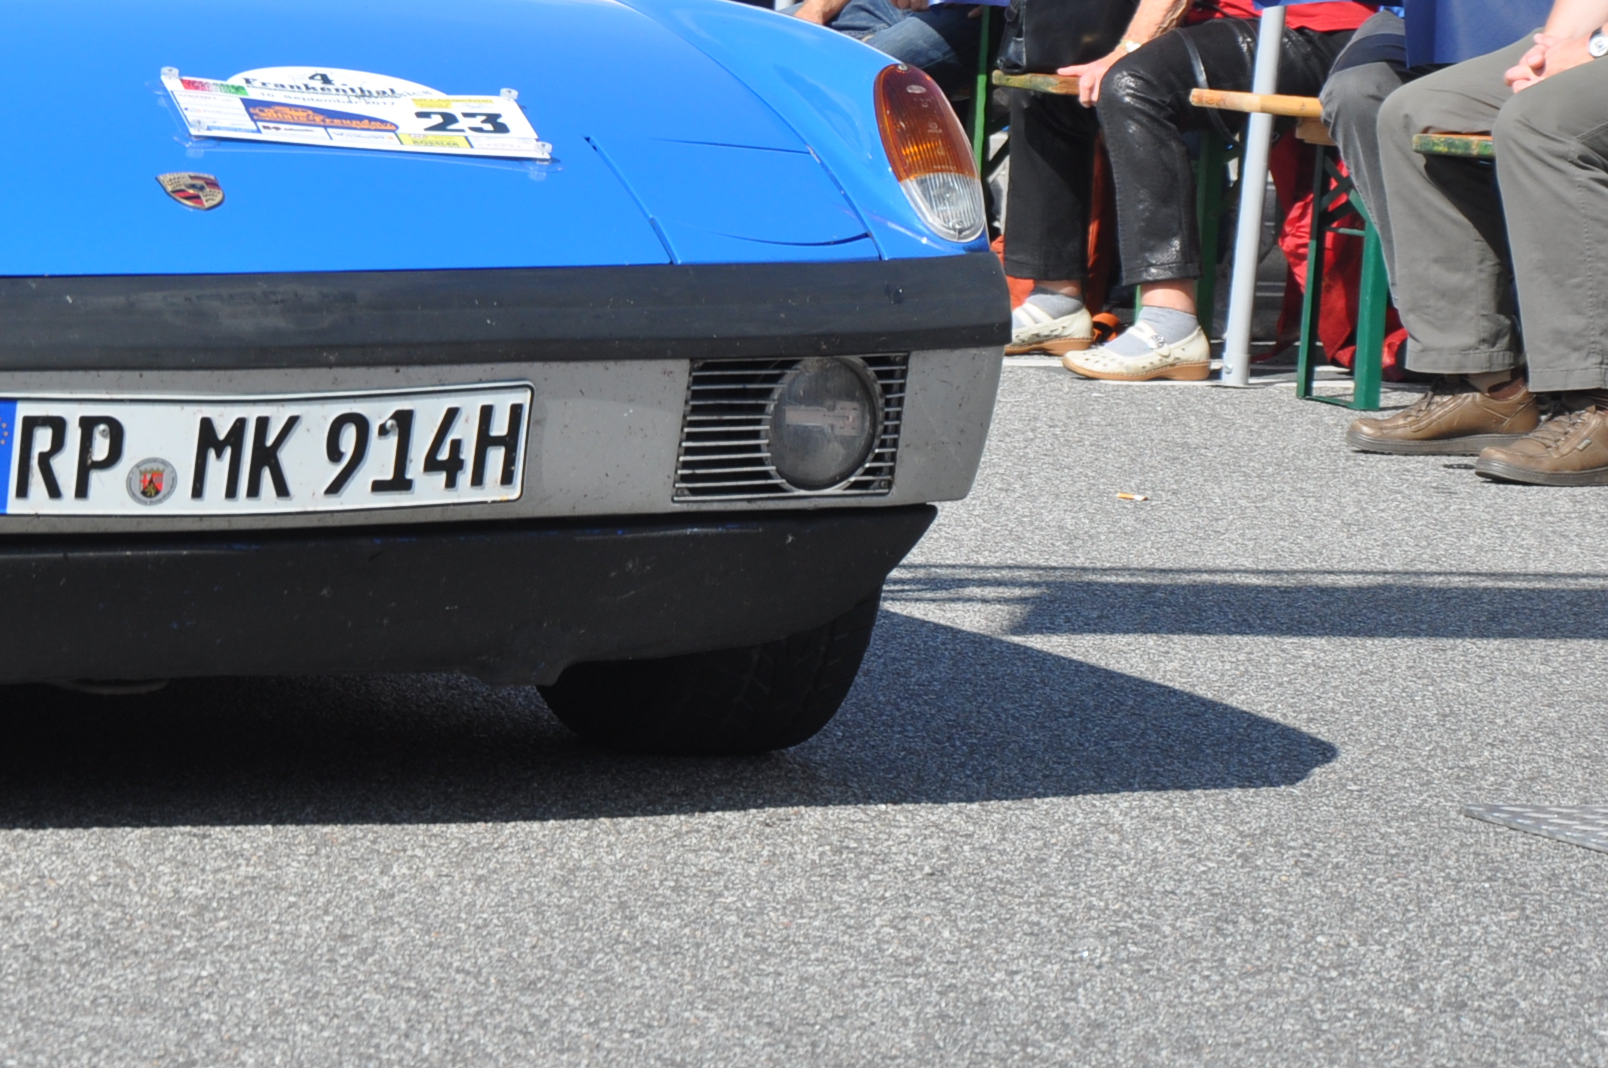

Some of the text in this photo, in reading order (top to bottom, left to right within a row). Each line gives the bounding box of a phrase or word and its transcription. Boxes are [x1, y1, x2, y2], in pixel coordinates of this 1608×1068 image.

[243, 78, 396, 99] Frankenthal
[414, 111, 511, 134] 23
[15, 403, 524, 500] RP MK 914H
